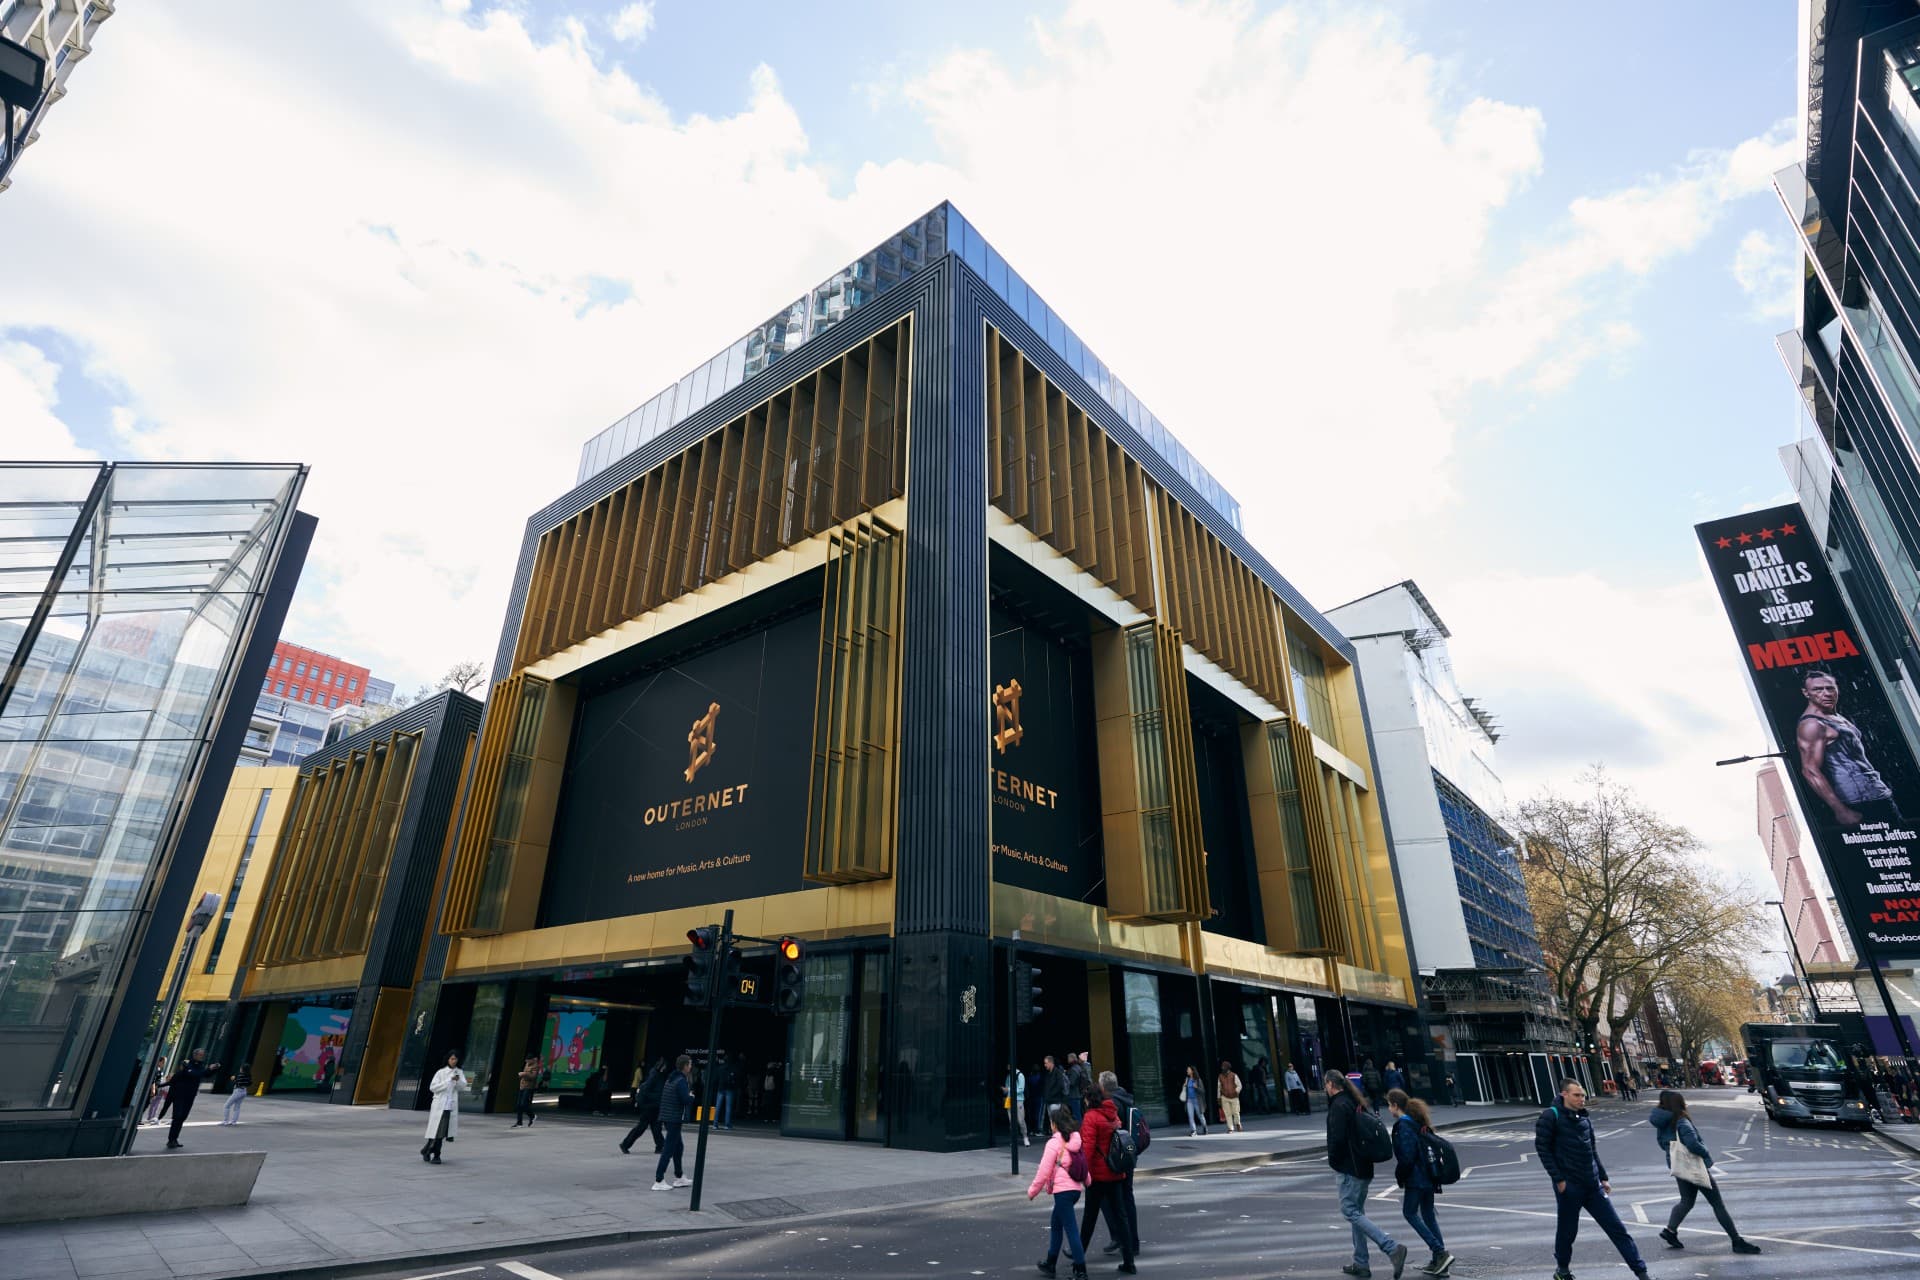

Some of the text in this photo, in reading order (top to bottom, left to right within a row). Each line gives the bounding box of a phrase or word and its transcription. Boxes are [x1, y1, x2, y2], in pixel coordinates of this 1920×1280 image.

[1733, 561, 1812, 594] DANIELS
[1771, 588, 1788, 605] IS
[1747, 630, 1860, 671] MEDEA
[991, 767, 1058, 809] ERNET
[644, 784, 749, 825] OUTERNET
[993, 794, 1025, 812] LONDON
[675, 817, 708, 831] LONDON
[1882, 821, 1890, 830] by
[1842, 829, 1918, 845] Robinson Jeffers
[992, 844, 1068, 873] or Music, Arts & Culture
[1862, 845, 1907, 856] From the play by
[627, 853, 751, 884] A new home for Music, Arts & Culture
[1867, 856, 1911, 869] Euripides
[1866, 881, 1905, 894] Dominic
[741, 979, 755, 995] 04
